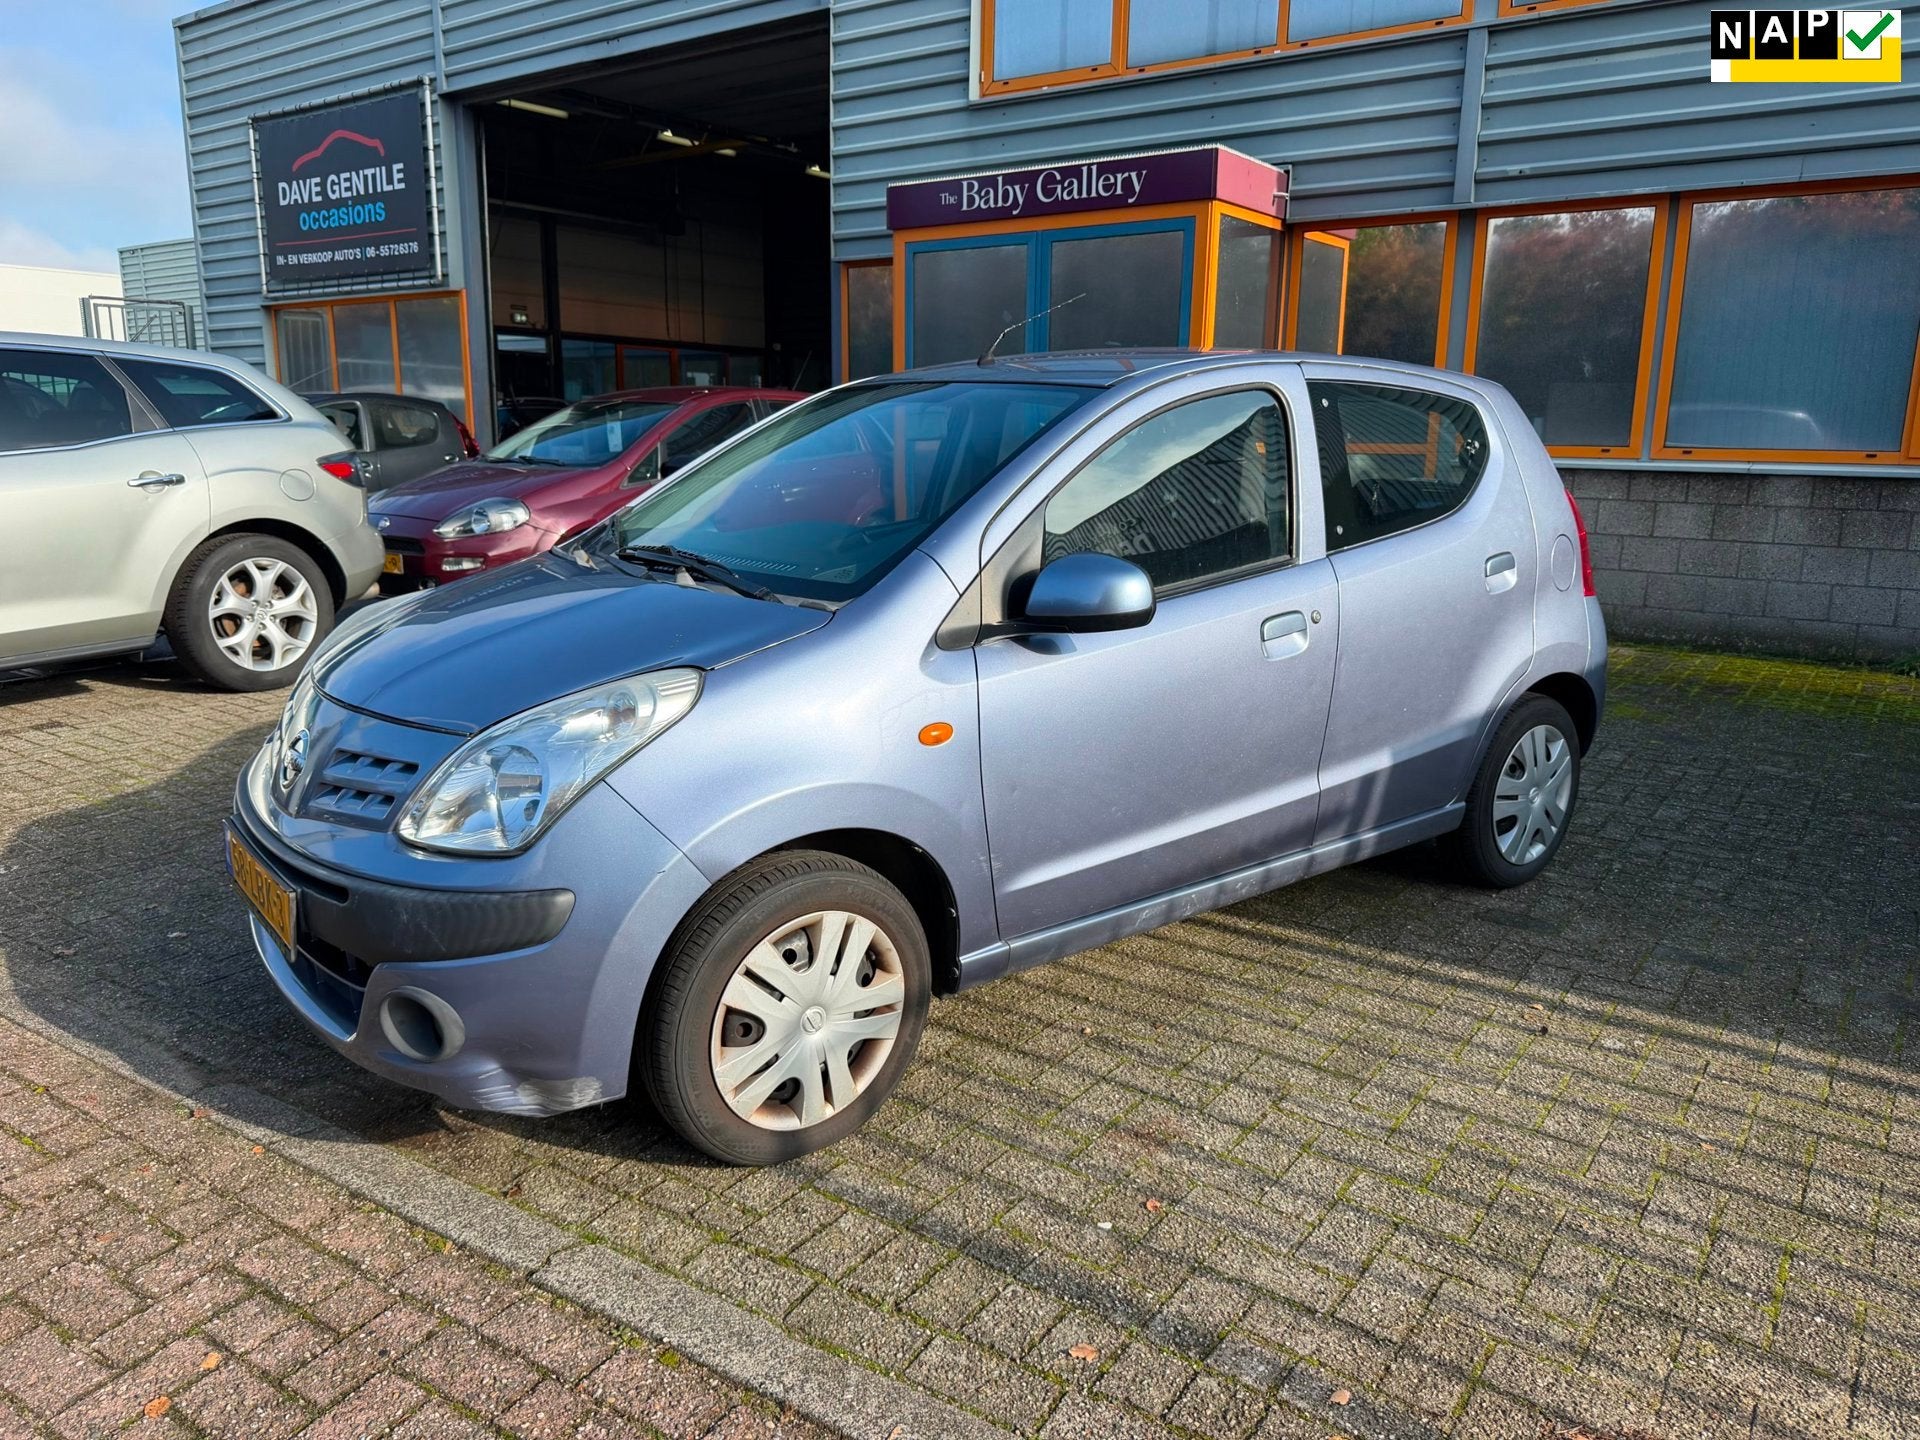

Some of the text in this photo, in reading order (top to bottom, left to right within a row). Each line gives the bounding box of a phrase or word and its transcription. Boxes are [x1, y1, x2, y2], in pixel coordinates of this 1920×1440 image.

[278, 162, 406, 206] DAVE GENTILE
[939, 164, 1148, 215] The Baby Gallery
[299, 200, 386, 231] occasions
[276, 255, 287, 266] IN-
[288, 254, 299, 265] EN
[299, 251, 333, 264] VERKOOP
[334, 247, 361, 261] AUTO'S
